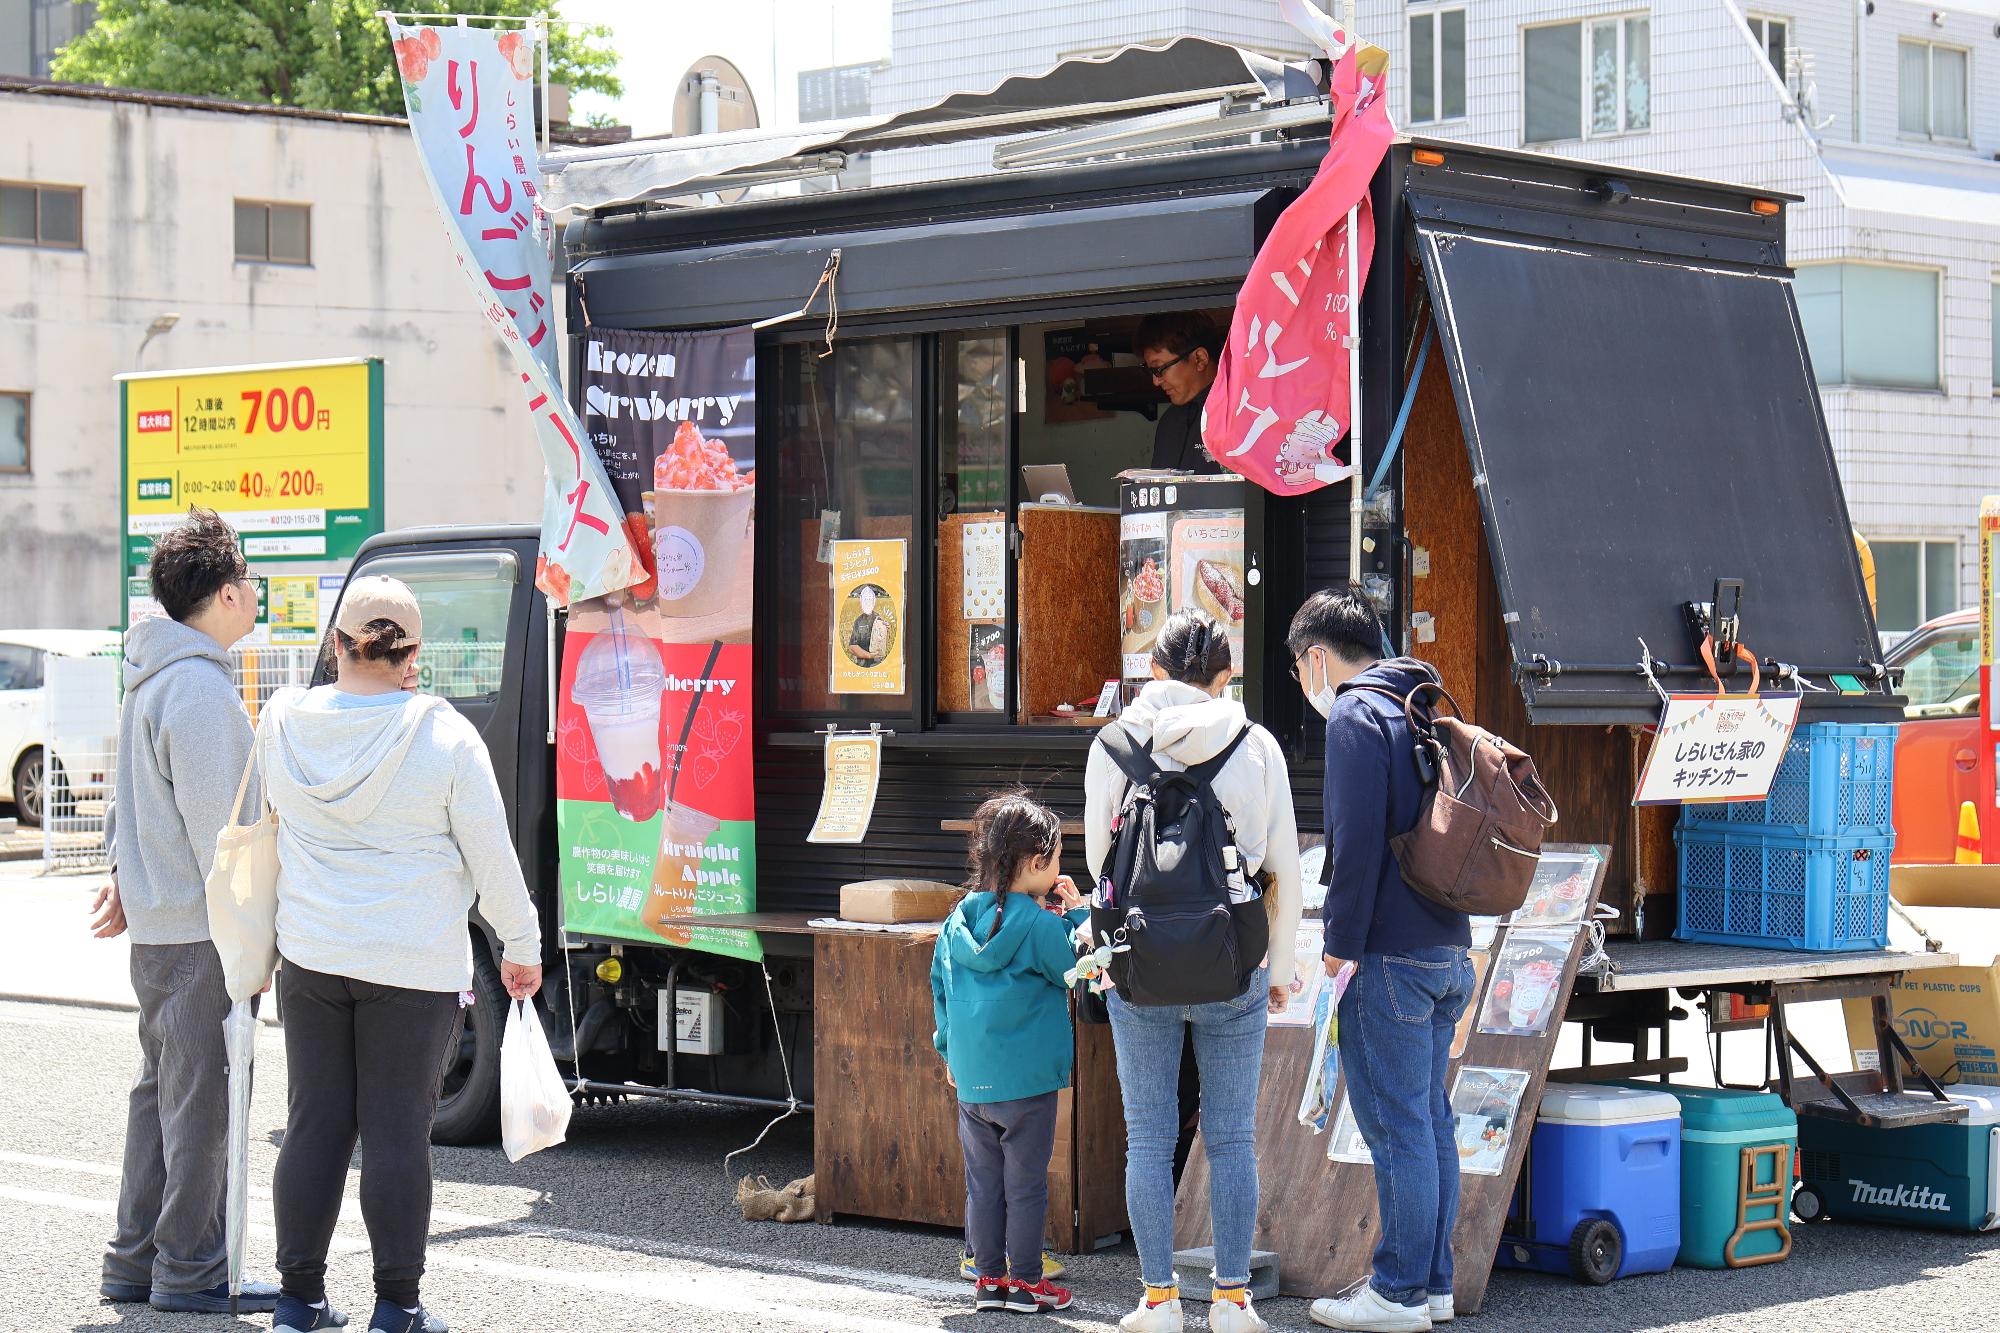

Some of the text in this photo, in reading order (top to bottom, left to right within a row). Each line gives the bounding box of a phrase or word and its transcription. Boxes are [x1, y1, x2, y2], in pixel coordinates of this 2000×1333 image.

[241, 386, 330, 434] 700円
[183, 415, 237, 433] 12時間以内
[980, 630, 1001, 647] ¥700
[1674, 740, 1766, 763] しらいさん家の
[1672, 765, 1749, 788] キッチンカー
[586, 862, 642, 880] 笑顔を届けます
[681, 864, 742, 888] Apple
[577, 880, 644, 913] しらい農園
[1515, 946, 1544, 961] ¥700
[1904, 981, 1919, 990] PET
[1923, 982, 1956, 992] PLASTIC
[1959, 984, 1982, 993] CUPS
